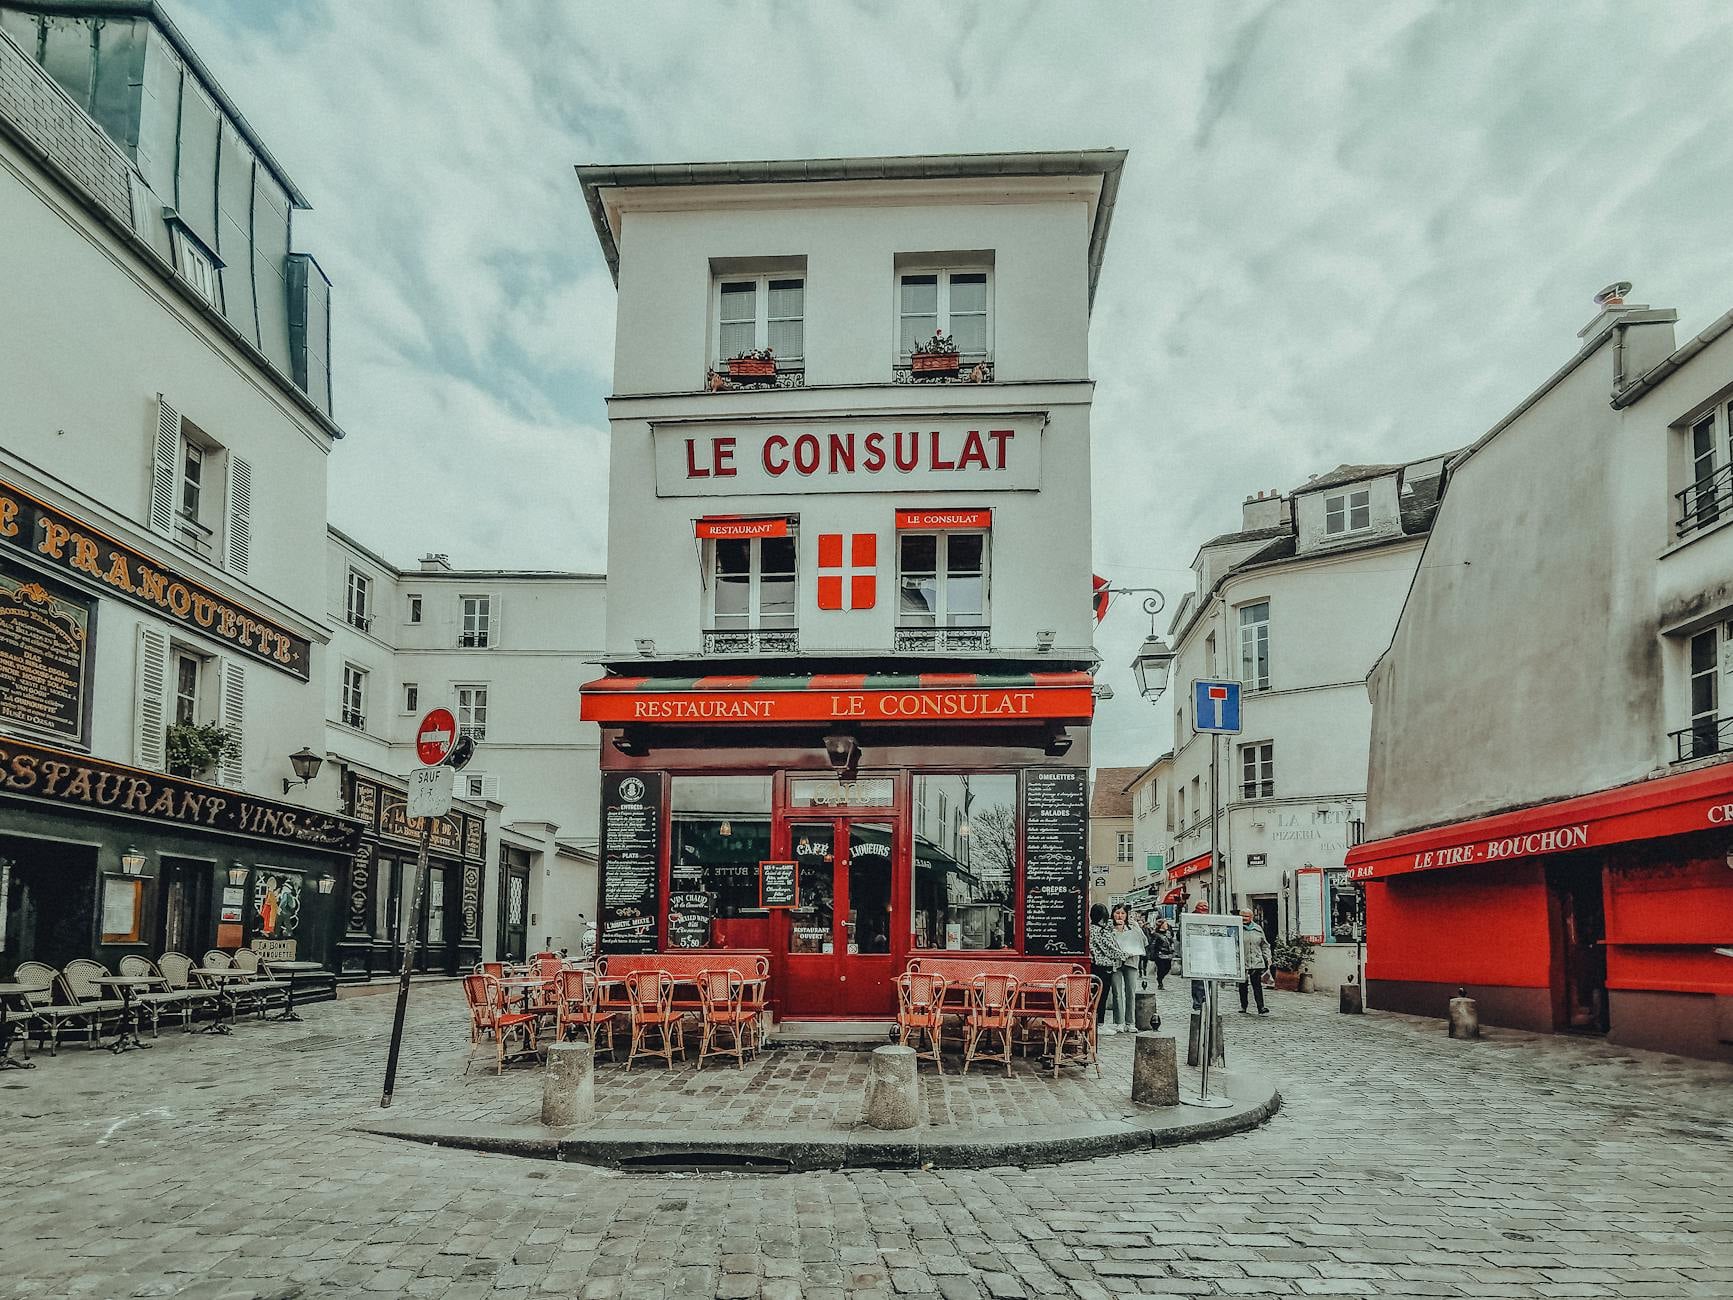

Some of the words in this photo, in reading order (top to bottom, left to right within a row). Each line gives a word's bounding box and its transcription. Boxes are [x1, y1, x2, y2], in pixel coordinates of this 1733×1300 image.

[685, 437, 737, 479] LE
[761, 430, 1015, 476] CONSULAT
[907, 515, 920, 524] LE
[923, 514, 979, 524] CONSULAT
[709, 524, 773, 536] RESTAURANT
[38, 517, 291, 664] FRANQUETTE
[634, 700, 775, 719] RESTAURANT
[830, 695, 865, 717] LE
[879, 693, 1035, 716] CONSULAT
[418, 771, 440, 784] SAUF
[0, 750, 227, 824] STAURANT
[240, 803, 298, 837] VINS
[1040, 809, 1071, 817] SALADES
[1272, 830, 1321, 841] PIZZERIA
[849, 842, 890, 858] LIQUEURS
[1413, 850, 1433, 869] LE
[1436, 846, 1475, 867] TIRE
[1486, 825, 1589, 859] BOUCHON
[1357, 866, 1375, 878] BAR
[670, 895, 684, 904] VIN
[685, 894, 708, 904] CHAUD
